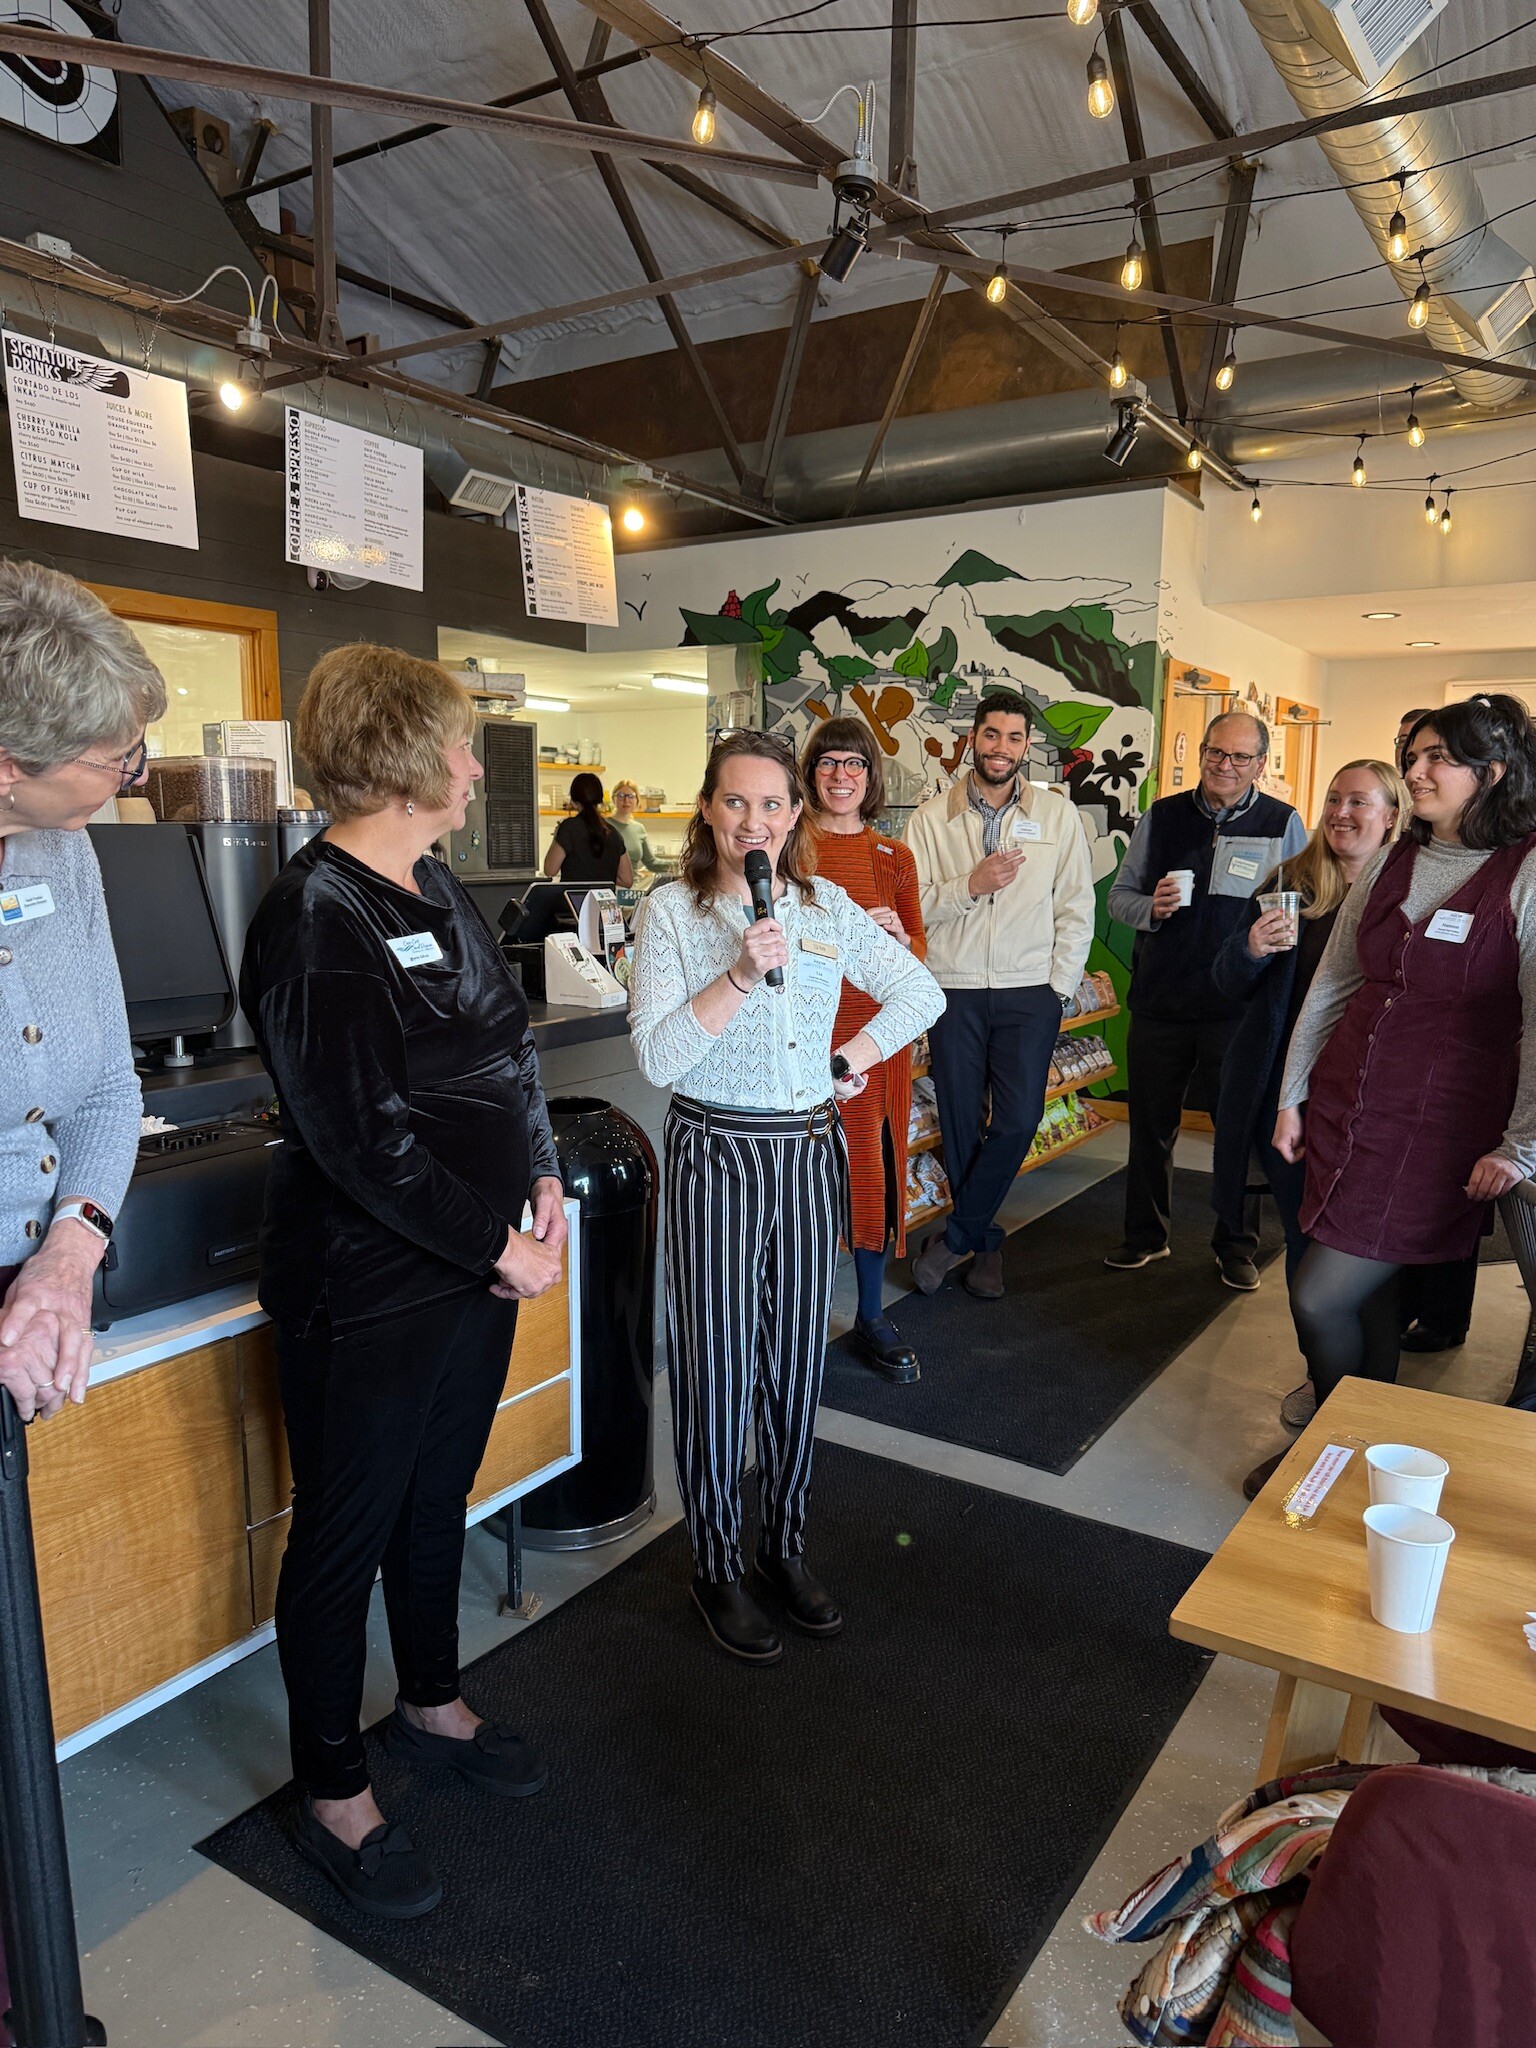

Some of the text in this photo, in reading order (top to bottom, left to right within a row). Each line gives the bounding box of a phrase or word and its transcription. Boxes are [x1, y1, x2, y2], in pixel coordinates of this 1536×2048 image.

[10, 338, 82, 372] SIGNATURE
[12, 354, 62, 382] DRINKS
[14, 376, 79, 400] CORTADO DE LOS
[14, 385, 37, 397] INKAS
[106, 402, 126, 414] JUICES
[135, 409, 153, 420] MORE
[17, 412, 80, 434] CHERRY VANILLA
[18, 422, 78, 442] ESPRESSO KOLA
[108, 422, 129, 431] ORANGE
[305, 420, 326, 432] ESPRESSO
[110, 444, 138, 454] LEMONADE
[364, 440, 379, 449] COFFEE
[20, 452, 80, 471] CITRUS MATCHA
[24, 481, 37, 489] CUP
[54, 487, 90, 500] SUNSHINE
[114, 486, 144, 496] CHOCOLATE
[289, 416, 301, 555] COFFEE & ESPRESSO
[519, 496, 536, 604] TEA & STEAMERS
